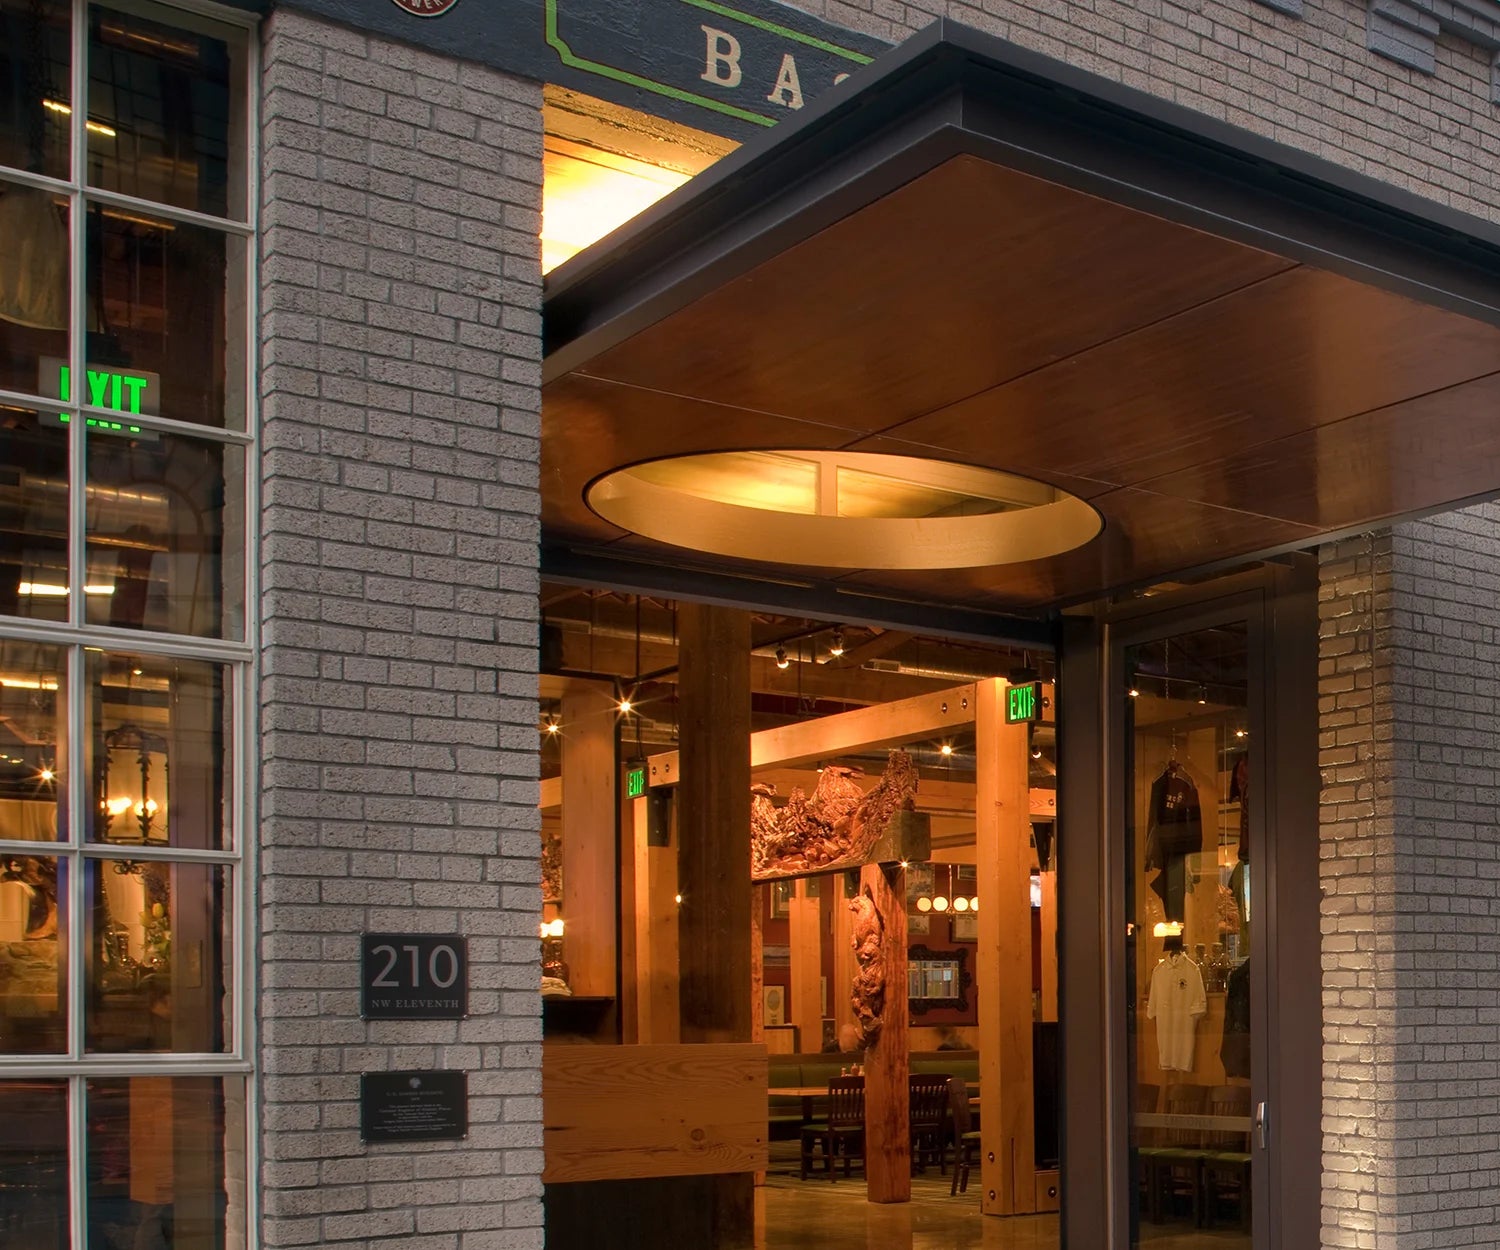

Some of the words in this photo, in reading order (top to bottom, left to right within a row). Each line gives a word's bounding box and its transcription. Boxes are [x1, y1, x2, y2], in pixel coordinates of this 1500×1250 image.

[699, 24, 852, 111] BA
[1010, 686, 1032, 721] EXIT
[629, 770, 643, 797] EXIT
[371, 944, 459, 989] 210
[371, 999, 390, 1009] NW
[396, 999, 459, 1009] ELEVENTH
